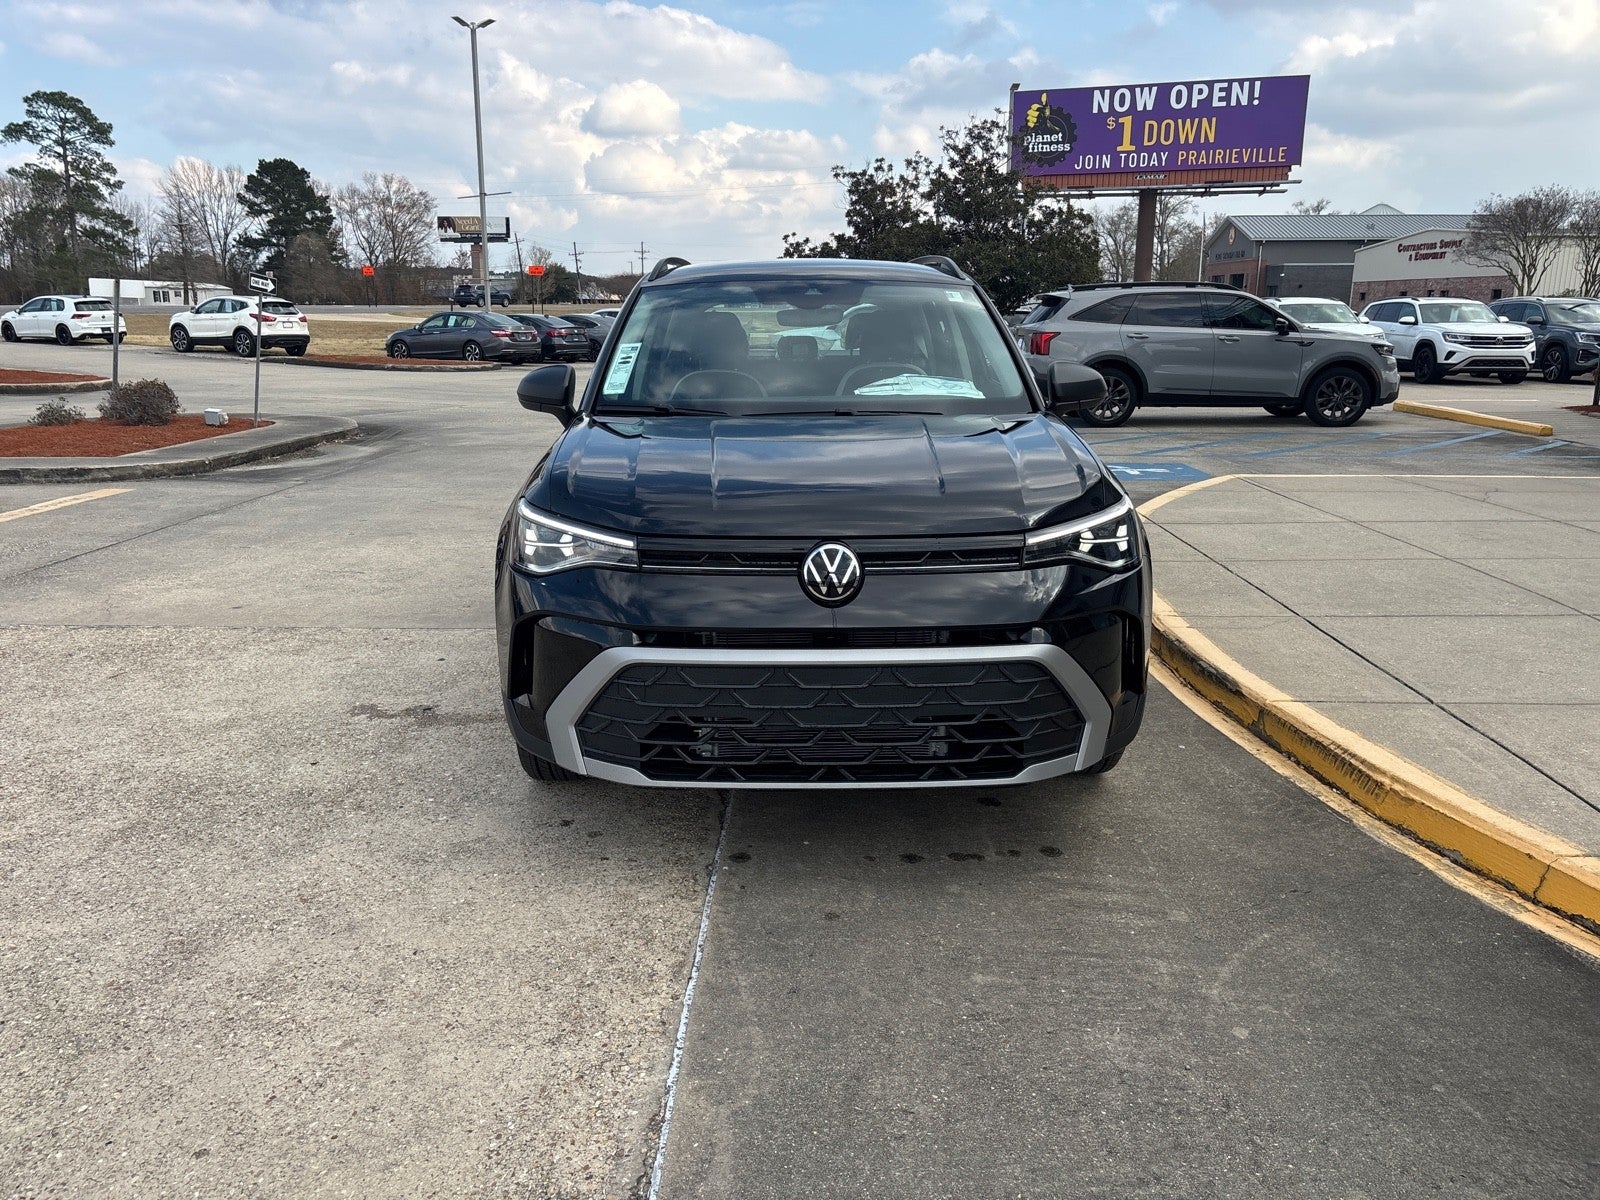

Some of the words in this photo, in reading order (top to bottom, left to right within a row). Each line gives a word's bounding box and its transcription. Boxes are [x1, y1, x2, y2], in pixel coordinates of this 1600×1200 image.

[1092, 86, 1158, 114] NOW
[1169, 80, 1261, 110] OPEN!
[1023, 132, 1063, 146] planet
[1106, 115, 1136, 152] $1
[1143, 116, 1217, 147] DOWN
[1028, 142, 1071, 153] fitness
[1075, 154, 1111, 170] JOIN
[1119, 151, 1169, 168] TODAY
[1177, 146, 1288, 166] PRAIRIEVILLE
